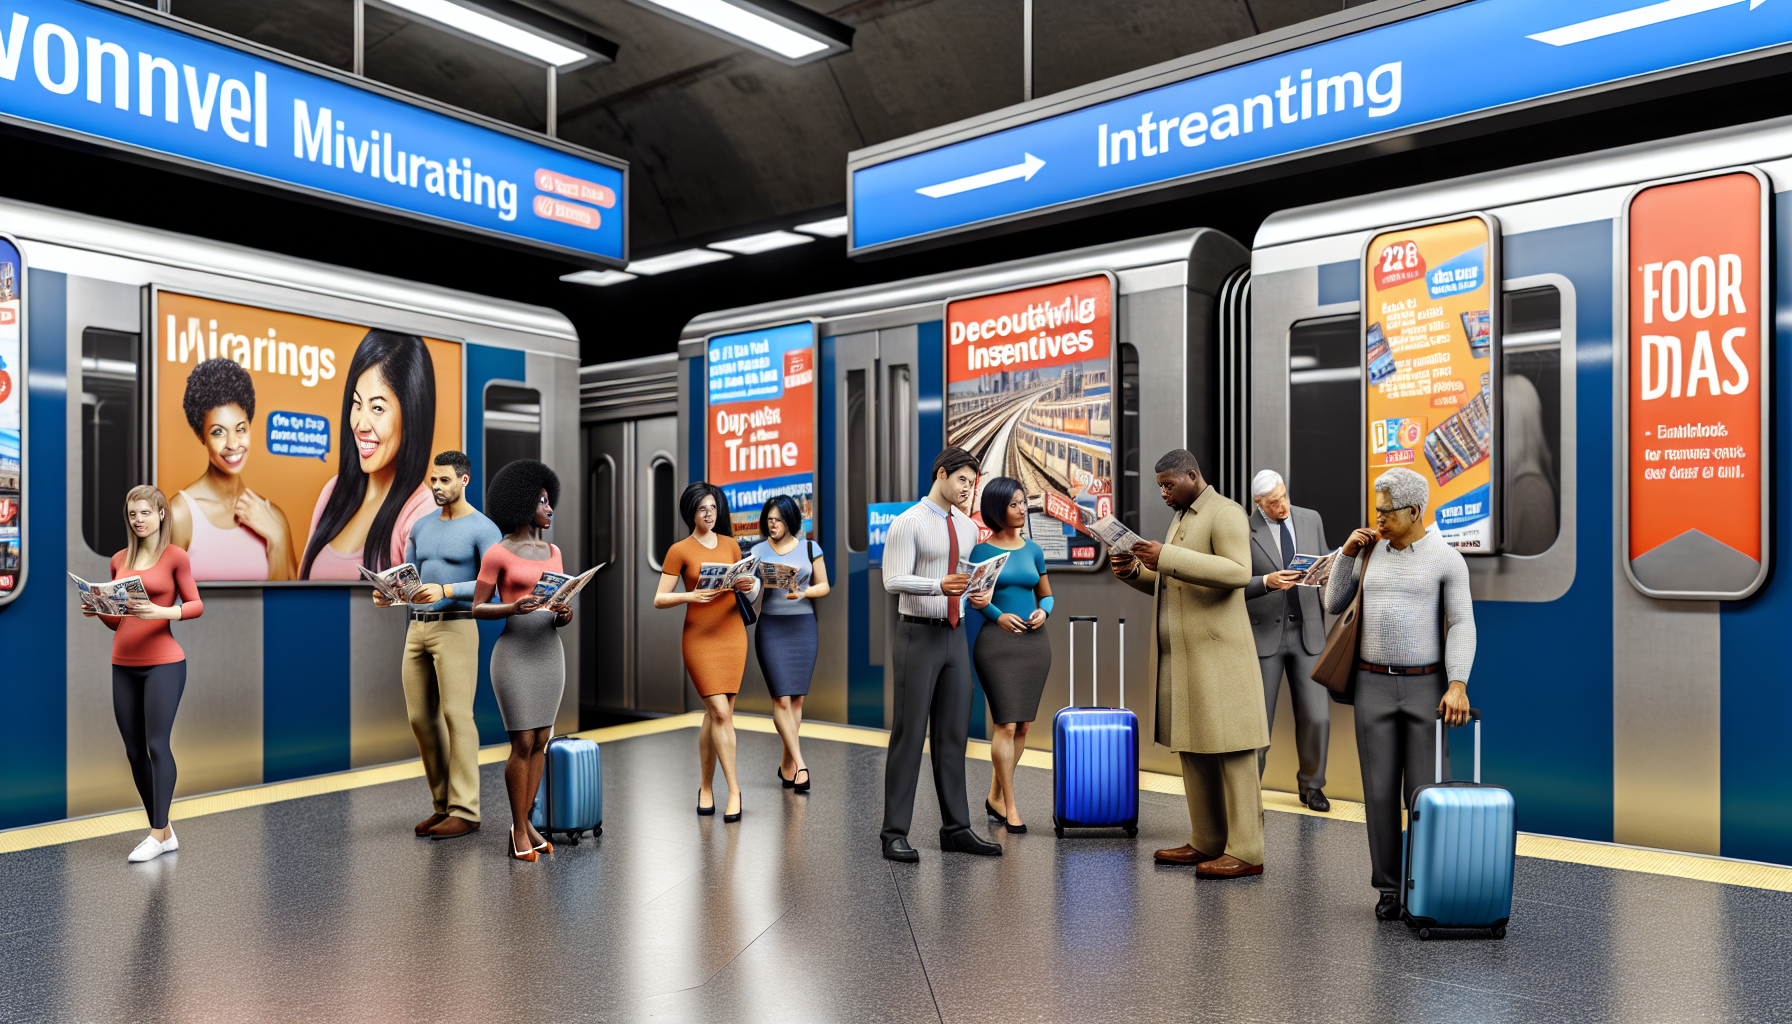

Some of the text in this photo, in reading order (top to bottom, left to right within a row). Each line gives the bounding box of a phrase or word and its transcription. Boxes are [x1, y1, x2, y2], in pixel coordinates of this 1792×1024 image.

[1098, 61, 1402, 167] Intreantimg
[294, 98, 517, 221] Mivilurating
[1643, 254, 1746, 323] FOOR
[725, 438, 798, 472] Trime
